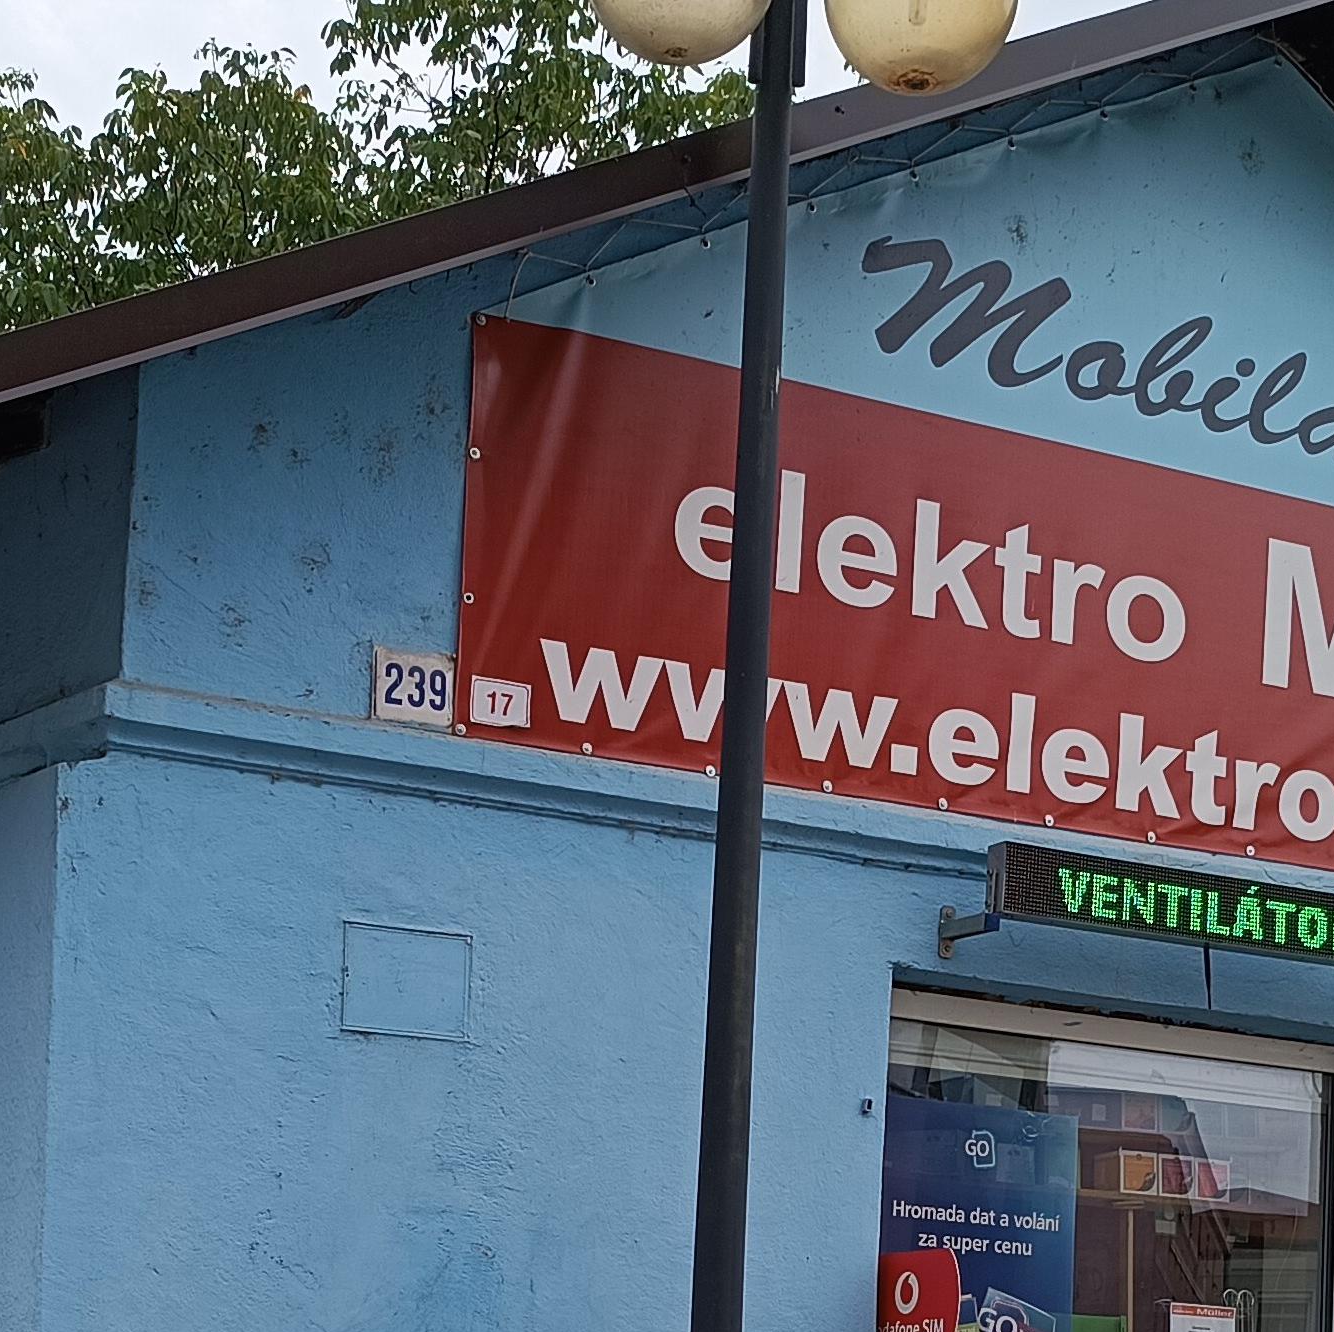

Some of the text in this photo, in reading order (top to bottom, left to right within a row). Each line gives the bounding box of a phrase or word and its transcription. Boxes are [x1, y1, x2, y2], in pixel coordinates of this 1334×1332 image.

[674, 468, 1186, 663] elektro
[384, 662, 447, 712] 239
[486, 691, 514, 717] 17
[965, 1139, 990, 1157] GO
[892, 1199, 1061, 1232] Hromada dat a volání
[918, 1233, 1033, 1256] za super cenu
